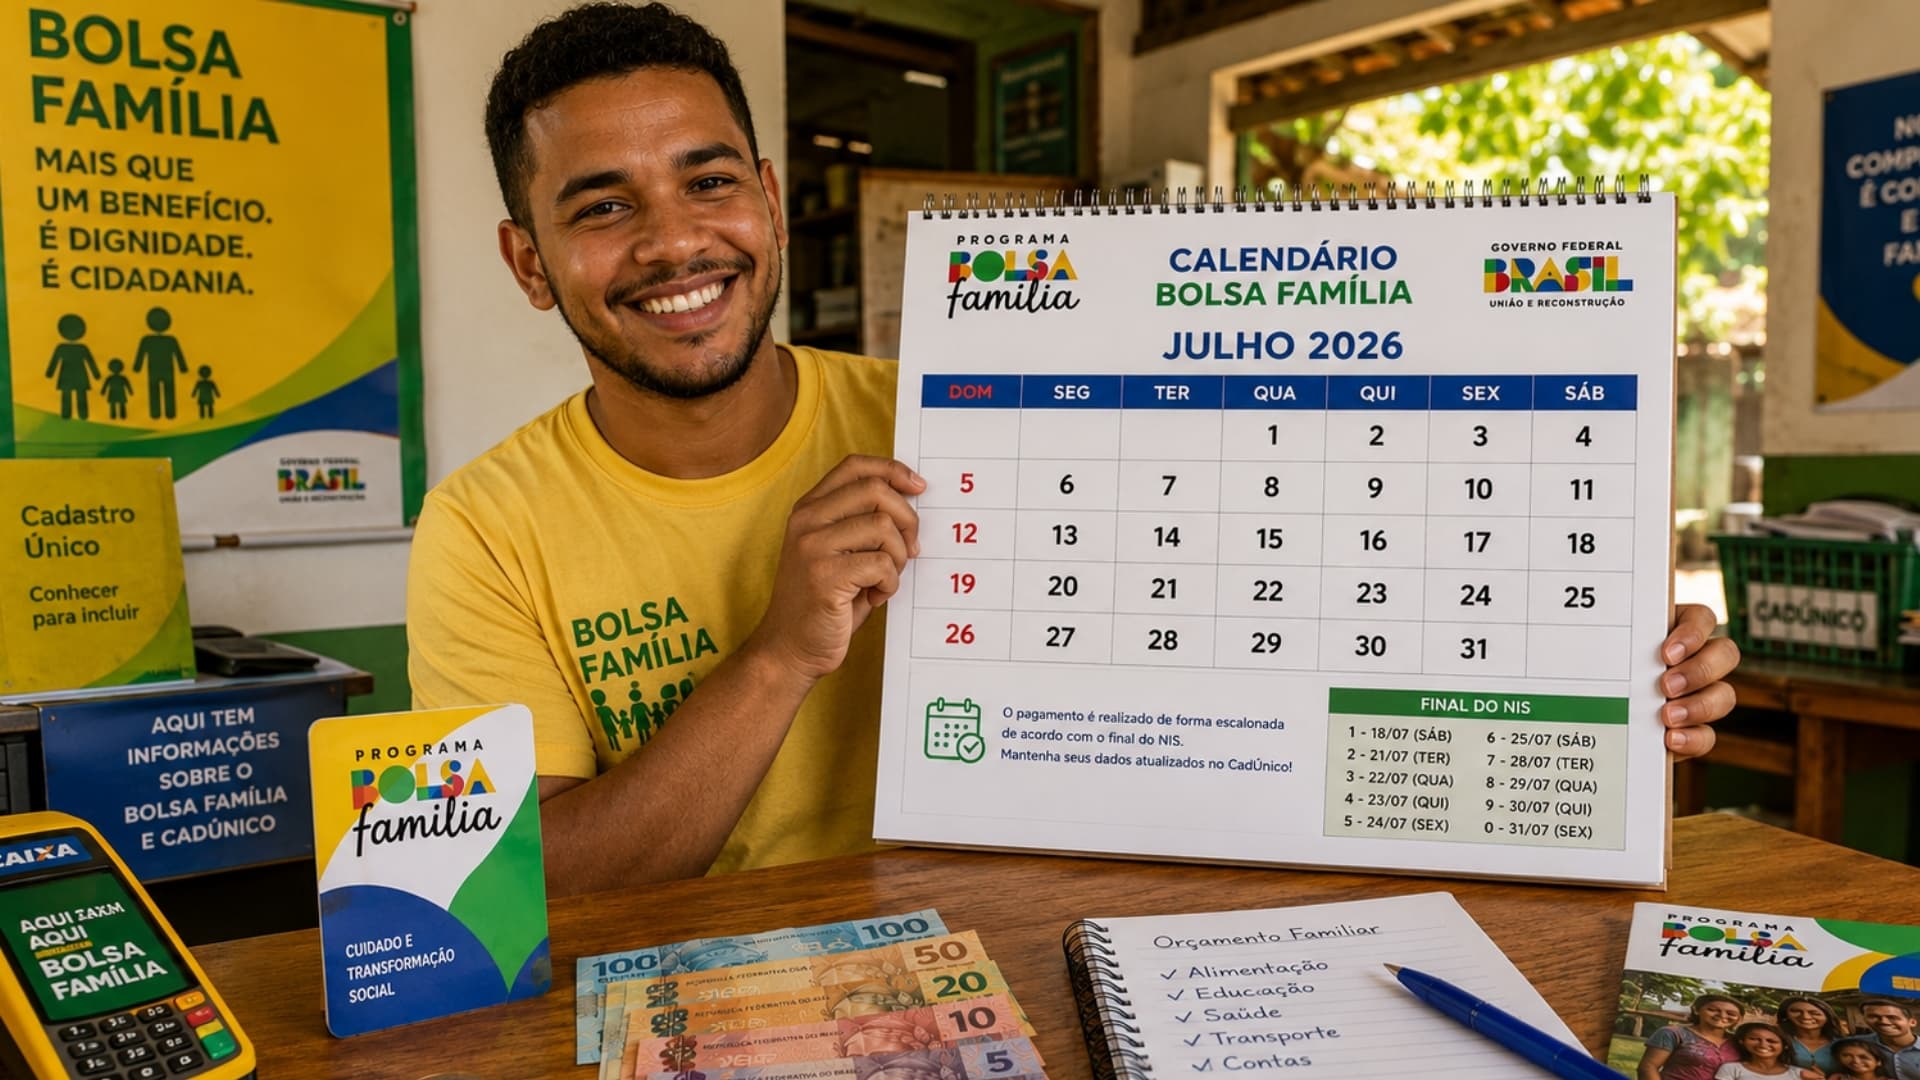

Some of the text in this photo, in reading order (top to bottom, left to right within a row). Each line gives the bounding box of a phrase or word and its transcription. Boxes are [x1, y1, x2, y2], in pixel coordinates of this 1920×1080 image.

[29, 8, 242, 79] BOLSA
[32, 75, 279, 144] FAMÍLIA
[36, 147, 194, 182] MAIS QUE
[1846, 145, 1920, 179] COMP
[1880, 176, 1920, 205] CO
[37, 186, 273, 224] UM BENEFÍCIO.
[39, 220, 253, 259] É DIGNIDADE.
[957, 234, 1070, 246] PROGRAMA
[1491, 241, 1623, 252] GOVERNO FEDERAL
[948, 249, 1078, 283] BOLSA
[1169, 239, 1398, 273] CALENDÁRIO
[41, 259, 254, 295] É CIDADANIA.
[1484, 256, 1633, 293] BRASIL
[1156, 274, 1413, 307] BOLSA FAMÍLIA
[1527, 299, 1534, 307] E
[1162, 331, 1404, 360] JULHO 2026
[949, 381, 1605, 402] DOM SEG TER QUA QUI SEX SÁB
[277, 467, 366, 493] BRASIL
[959, 473, 1594, 501] 5 6 7 8 9 10 11
[21, 504, 136, 527] Cadastro
[24, 533, 100, 559] Único
[30, 583, 119, 602] Conhecer
[33, 604, 140, 630] para incluir
[571, 596, 689, 648] BOLSA
[945, 624, 1488, 660] 26 27 28 29 30 31
[579, 627, 719, 684] FAMÍLIA
[1421, 697, 1531, 714] FINAL DO NIS
[152, 707, 255, 734] AQUI TEM
[1003, 707, 1285, 730] O pagamento é realizado de forma escalonada
[1002, 728, 1017, 739] de
[1020, 729, 1063, 741] acordo
[1067, 733, 1093, 742] com
[1109, 731, 1135, 744] final
[1139, 734, 1154, 745] do
[1158, 734, 1184, 747] NIS.
[1349, 726, 1452, 743] 1 18/07 (SÁB)
[1487, 731, 1596, 749] 6 25/07 (SÁB)
[128, 731, 280, 765] INFORMAÇÕES
[356, 739, 484, 761] PROGRAMA
[1347, 748, 1451, 766] 2 21/07 (TER)
[1001, 749, 1292, 773] Mantenha seus dados atualizados no CadÚnico!
[1487, 754, 1594, 772] 7 28/07 (TER)
[160, 763, 253, 790] SOBRE O
[351, 757, 496, 810] BOLSA
[1346, 770, 1454, 788] 3 22/07 (QUA)
[1486, 776, 1597, 795] 8 29/07 (QUA)
[124, 785, 288, 824] BOLSA FAMÍLIA
[1344, 792, 1449, 811] 4 23/07 (QUI)
[1485, 799, 1592, 817] 9 30/07 (QUI)
[141, 815, 276, 850] E CADÚNICO
[1344, 815, 1449, 833] 5 24/07 (SEX)
[1484, 821, 1593, 840] 0 31/07 (SEX)
[20, 911, 74, 934] AQUI
[862, 918, 929, 940] 100
[1667, 913, 1795, 932] PROGRAMA
[30, 925, 88, 950] AQUI
[345, 933, 414, 958] CUIDADO E
[1153, 924, 1380, 950] Orçamento Familiar
[1661, 921, 1809, 952] BOLSA
[39, 941, 146, 979] BOLSA
[914, 941, 967, 965] 50
[50, 960, 168, 1000] FAMÍLIA
[349, 982, 395, 1003] SOCIAL
[932, 971, 988, 998] 20
[948, 1007, 996, 1032] 10
[1209, 1026, 1342, 1046] Transporte
[986, 1049, 1014, 1073] 5
[1223, 1054, 1313, 1071] Contas
